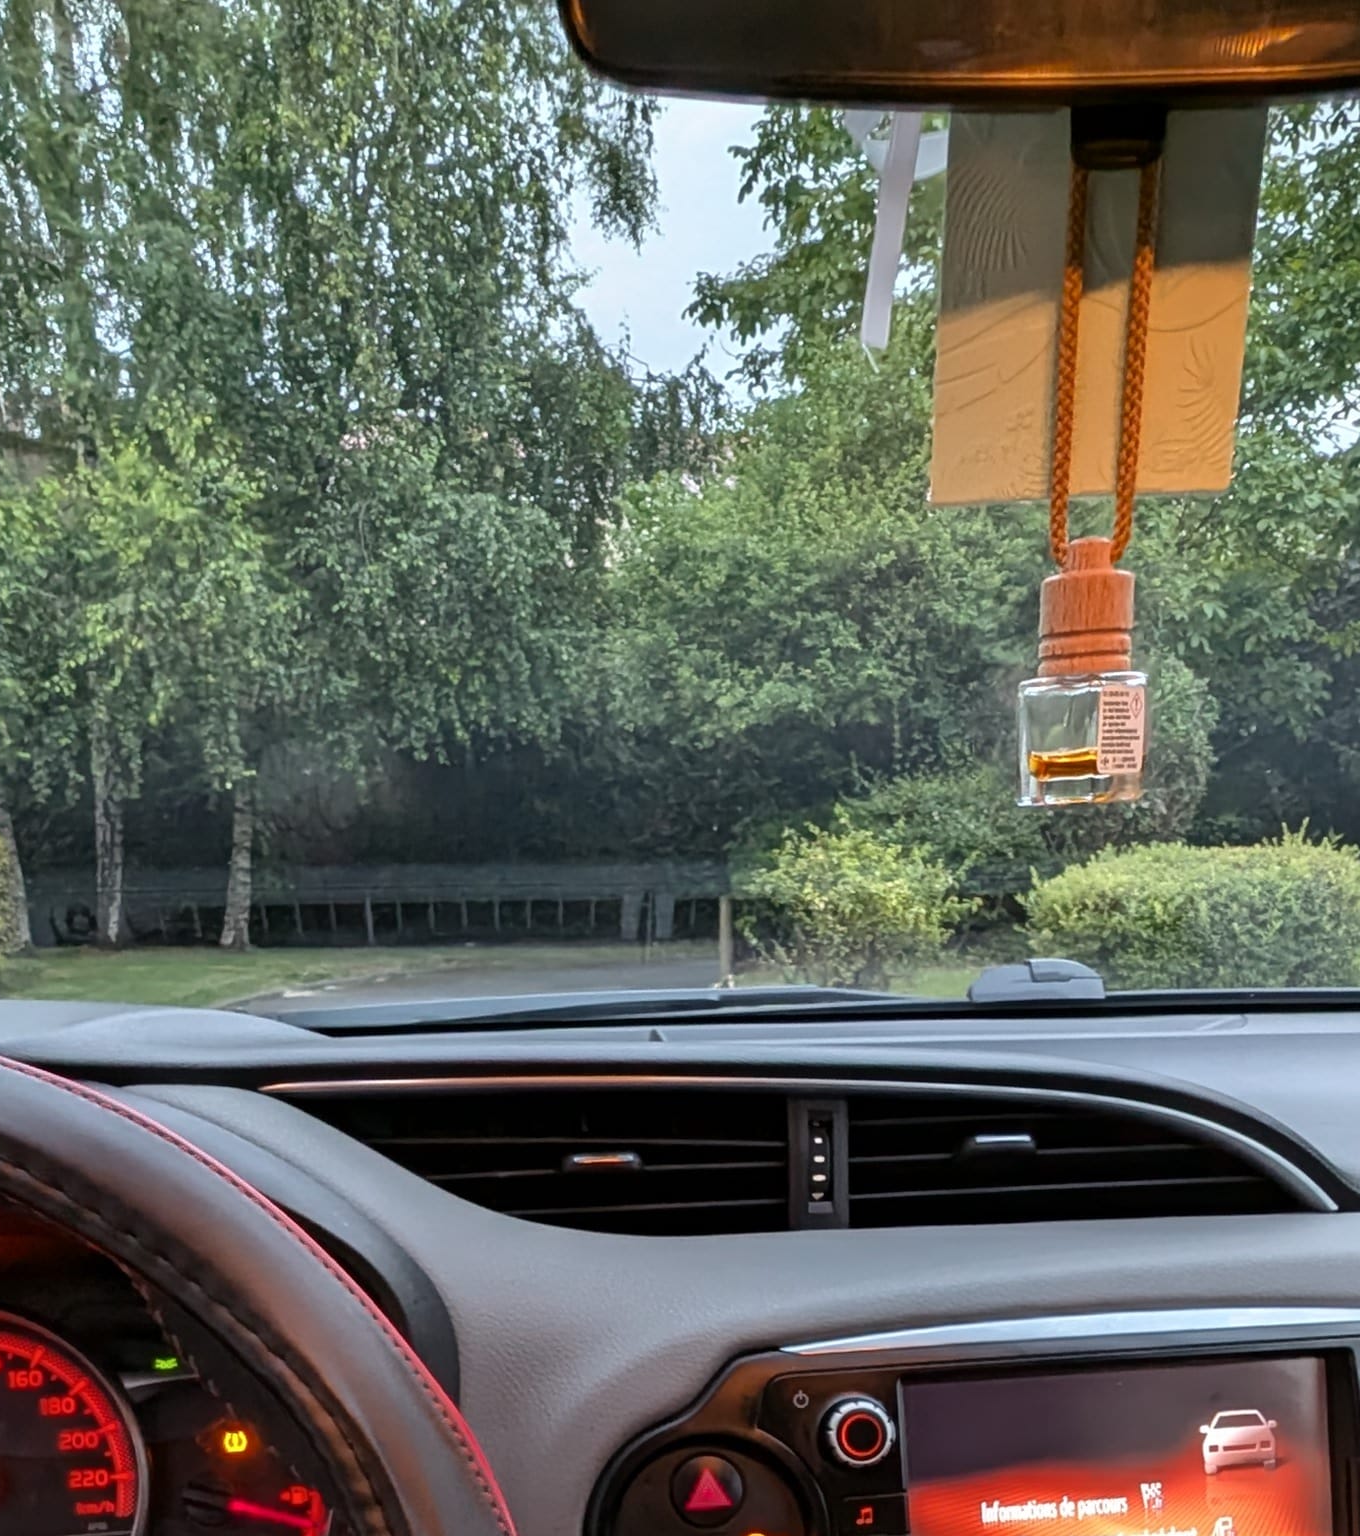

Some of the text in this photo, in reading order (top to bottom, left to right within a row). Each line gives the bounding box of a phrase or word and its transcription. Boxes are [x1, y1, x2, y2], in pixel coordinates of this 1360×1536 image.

[8, 1371, 42, 1388] 160
[41, 1398, 76, 1415] 180
[59, 1432, 98, 1449] 200
[69, 1470, 109, 1488] 220
[980, 1496, 1128, 1523] Informations de parcours
